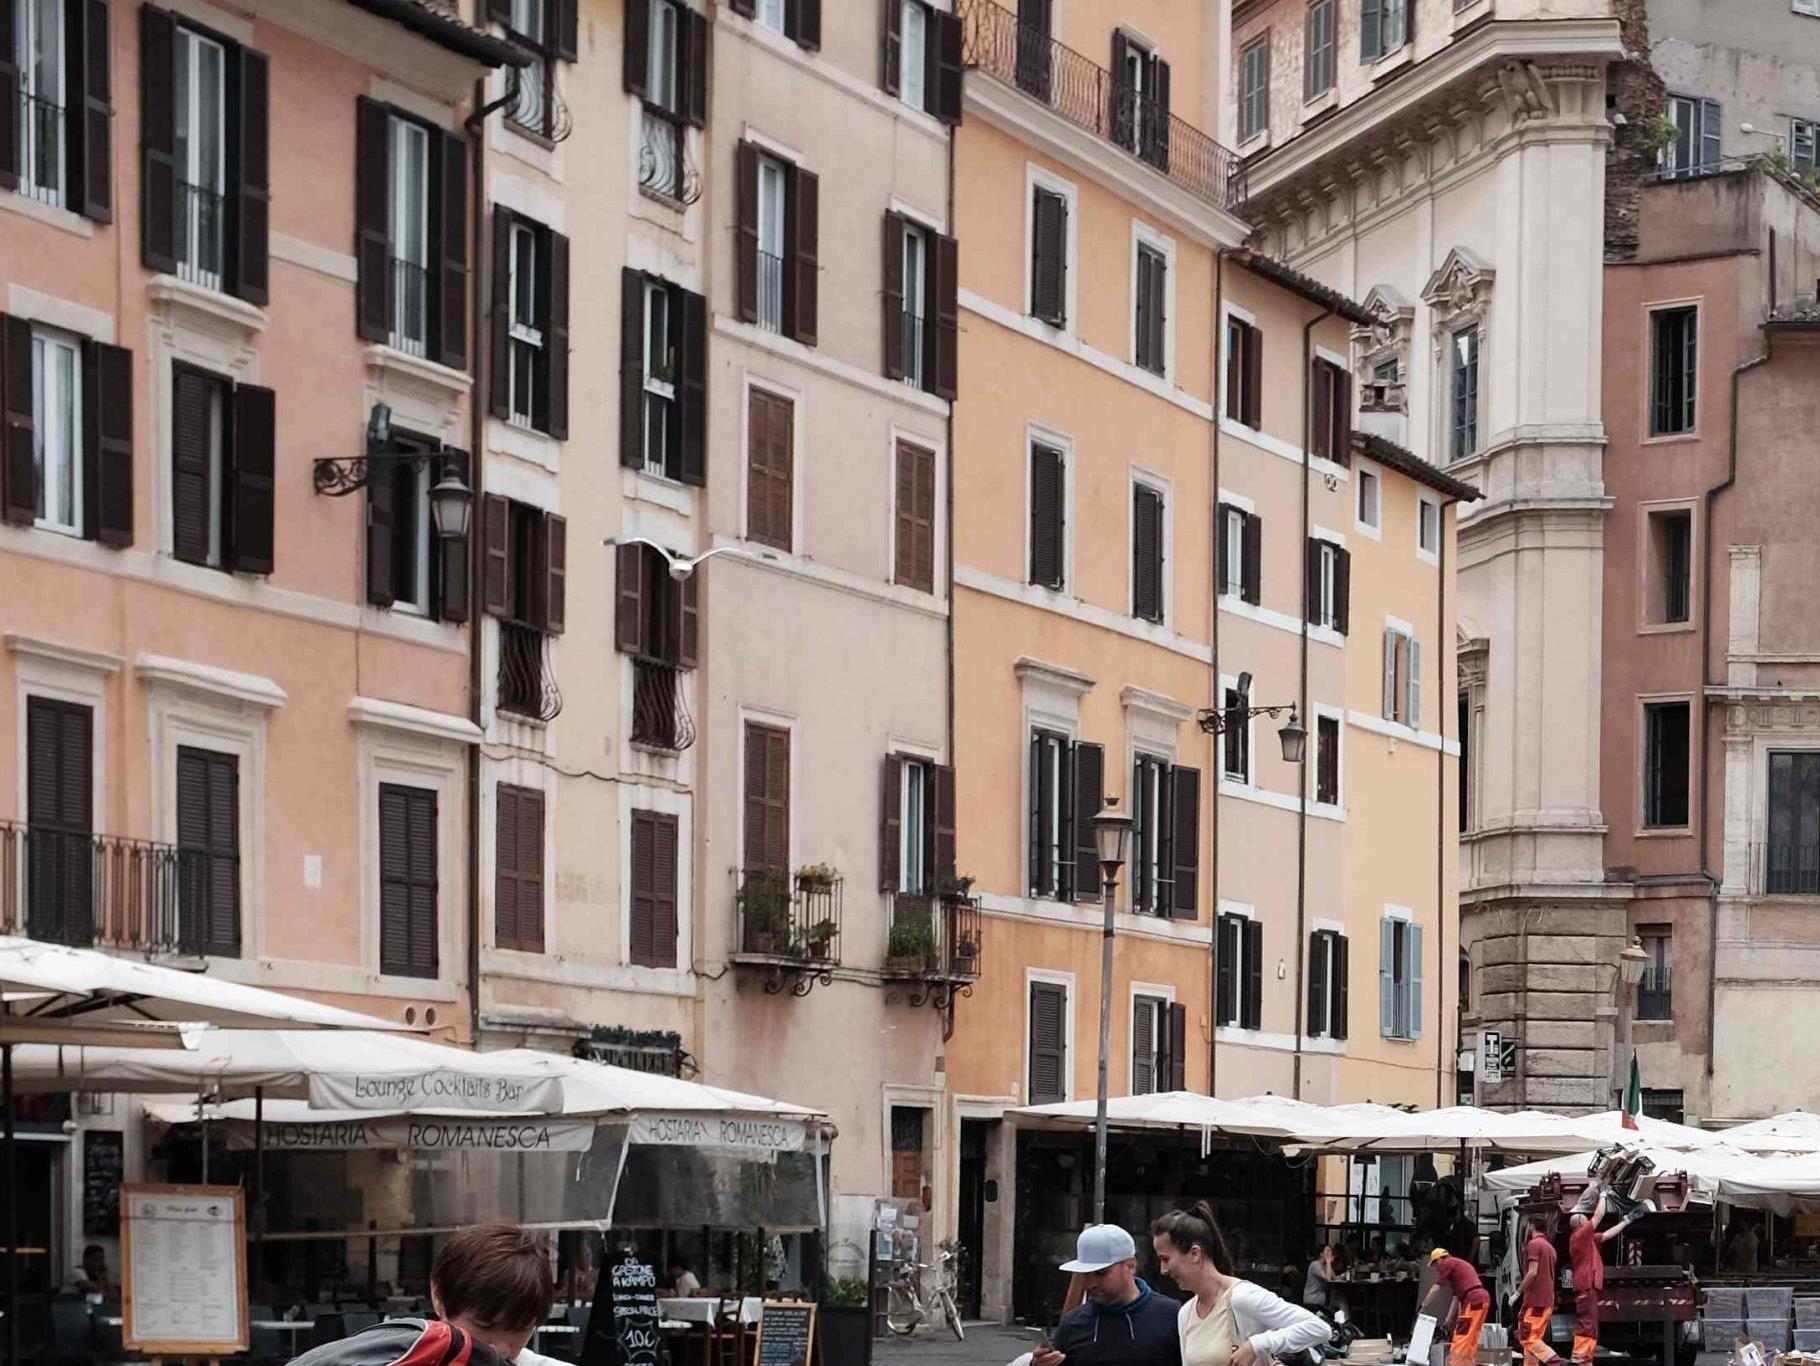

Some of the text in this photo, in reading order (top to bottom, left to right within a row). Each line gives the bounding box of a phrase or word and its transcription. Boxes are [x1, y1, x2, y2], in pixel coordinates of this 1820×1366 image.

[354, 1073, 524, 1103] Lounge Cocktails Bar
[266, 1123, 551, 1149] HOSTARIA ROMANESCA
[651, 1118, 788, 1147] HOSTARIA ROMANESCA
